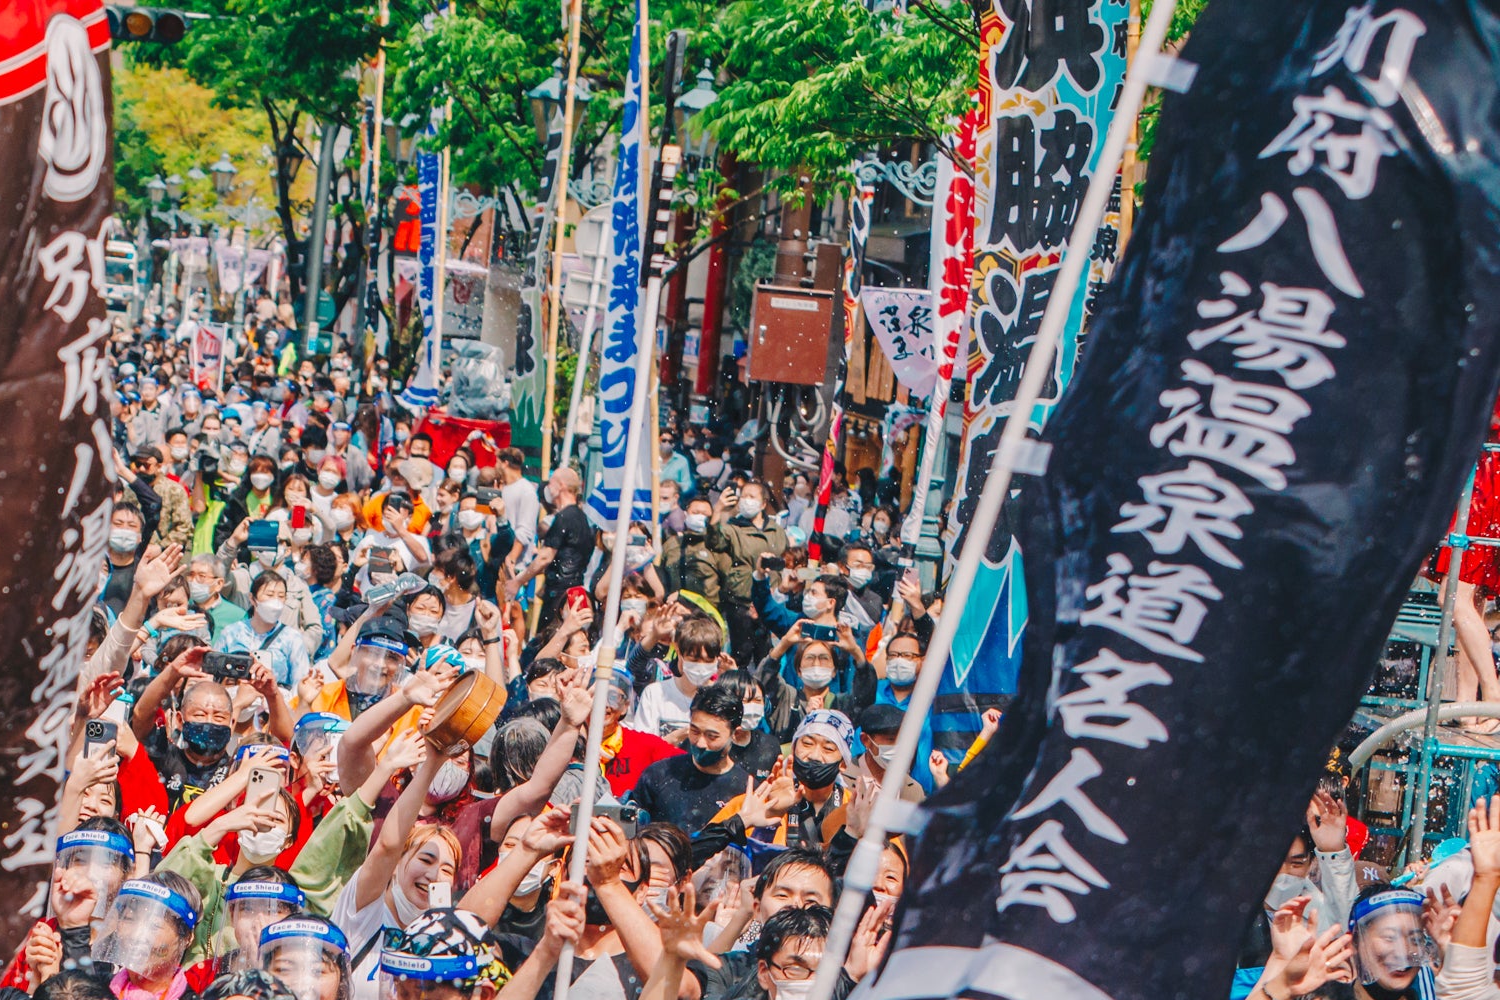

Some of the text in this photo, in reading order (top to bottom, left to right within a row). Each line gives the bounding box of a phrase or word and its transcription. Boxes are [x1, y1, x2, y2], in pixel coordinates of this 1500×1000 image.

[65, 833, 78, 841] Face
[141, 884, 166, 896] Shield
[254, 884, 280, 892] Shield
[294, 923, 324, 931] Shield
